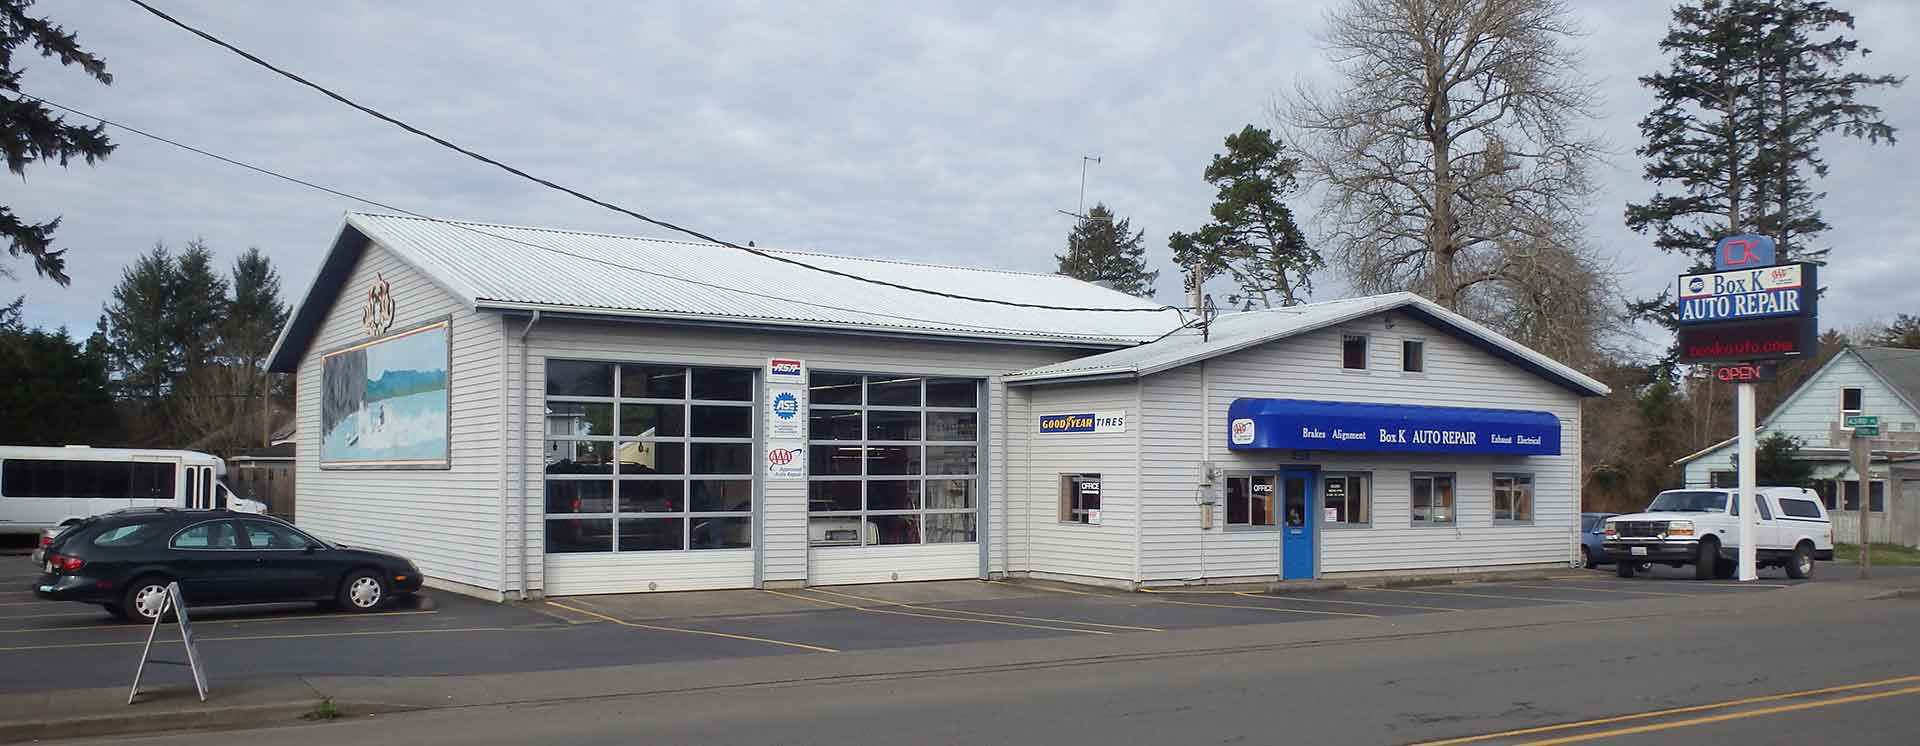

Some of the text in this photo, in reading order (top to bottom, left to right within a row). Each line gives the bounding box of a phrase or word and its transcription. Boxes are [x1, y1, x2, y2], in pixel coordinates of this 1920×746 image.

[1714, 271, 1763, 294] Box K
[1683, 290, 1799, 320] AUTO REPAIR
[1718, 366, 1760, 380] OPEN
[1042, 417, 1123, 429] GOODYEAR TIRES
[1302, 427, 1541, 445] Brakes Alignment Box K AUTO REPAIR Exhaust Electrical
[769, 449, 792, 465] AAA
[1081, 482, 1099, 490] OFFICE
[1253, 484, 1273, 492] OFFICE
